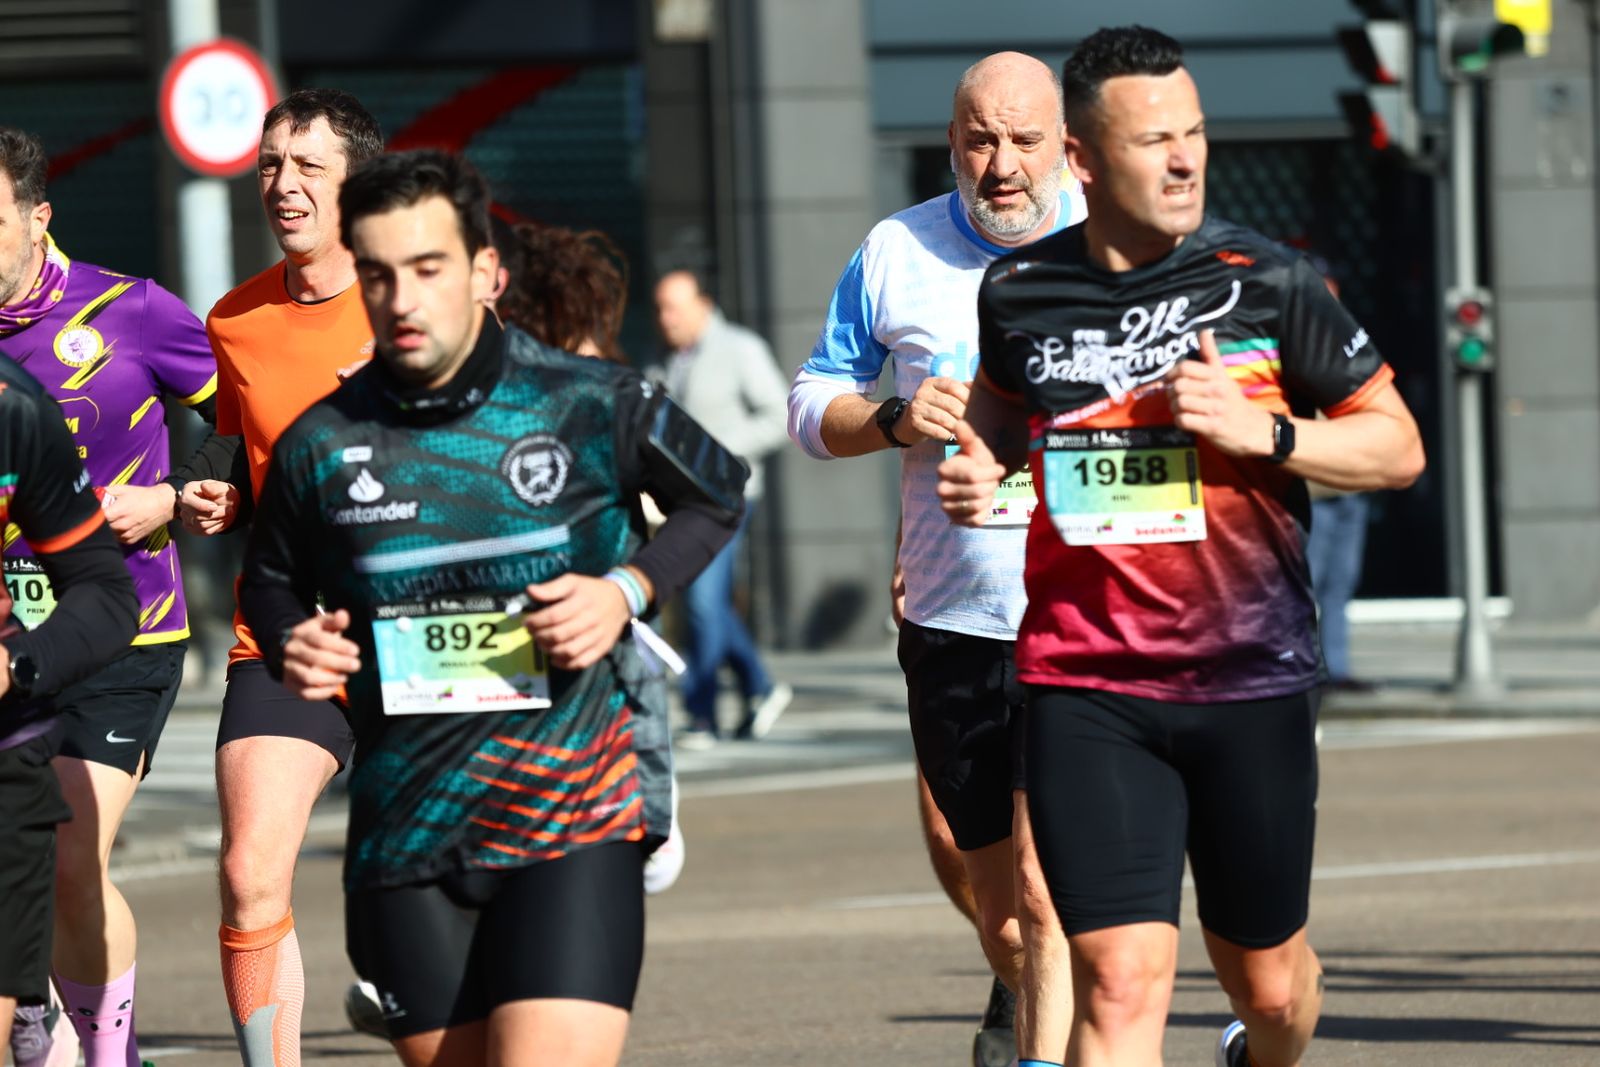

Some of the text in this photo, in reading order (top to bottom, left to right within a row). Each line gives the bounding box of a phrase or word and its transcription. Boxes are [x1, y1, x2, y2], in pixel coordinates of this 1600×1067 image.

[1074, 456, 1168, 486] 1958
[8, 579, 53, 601] 10
[424, 622, 498, 652] 892
